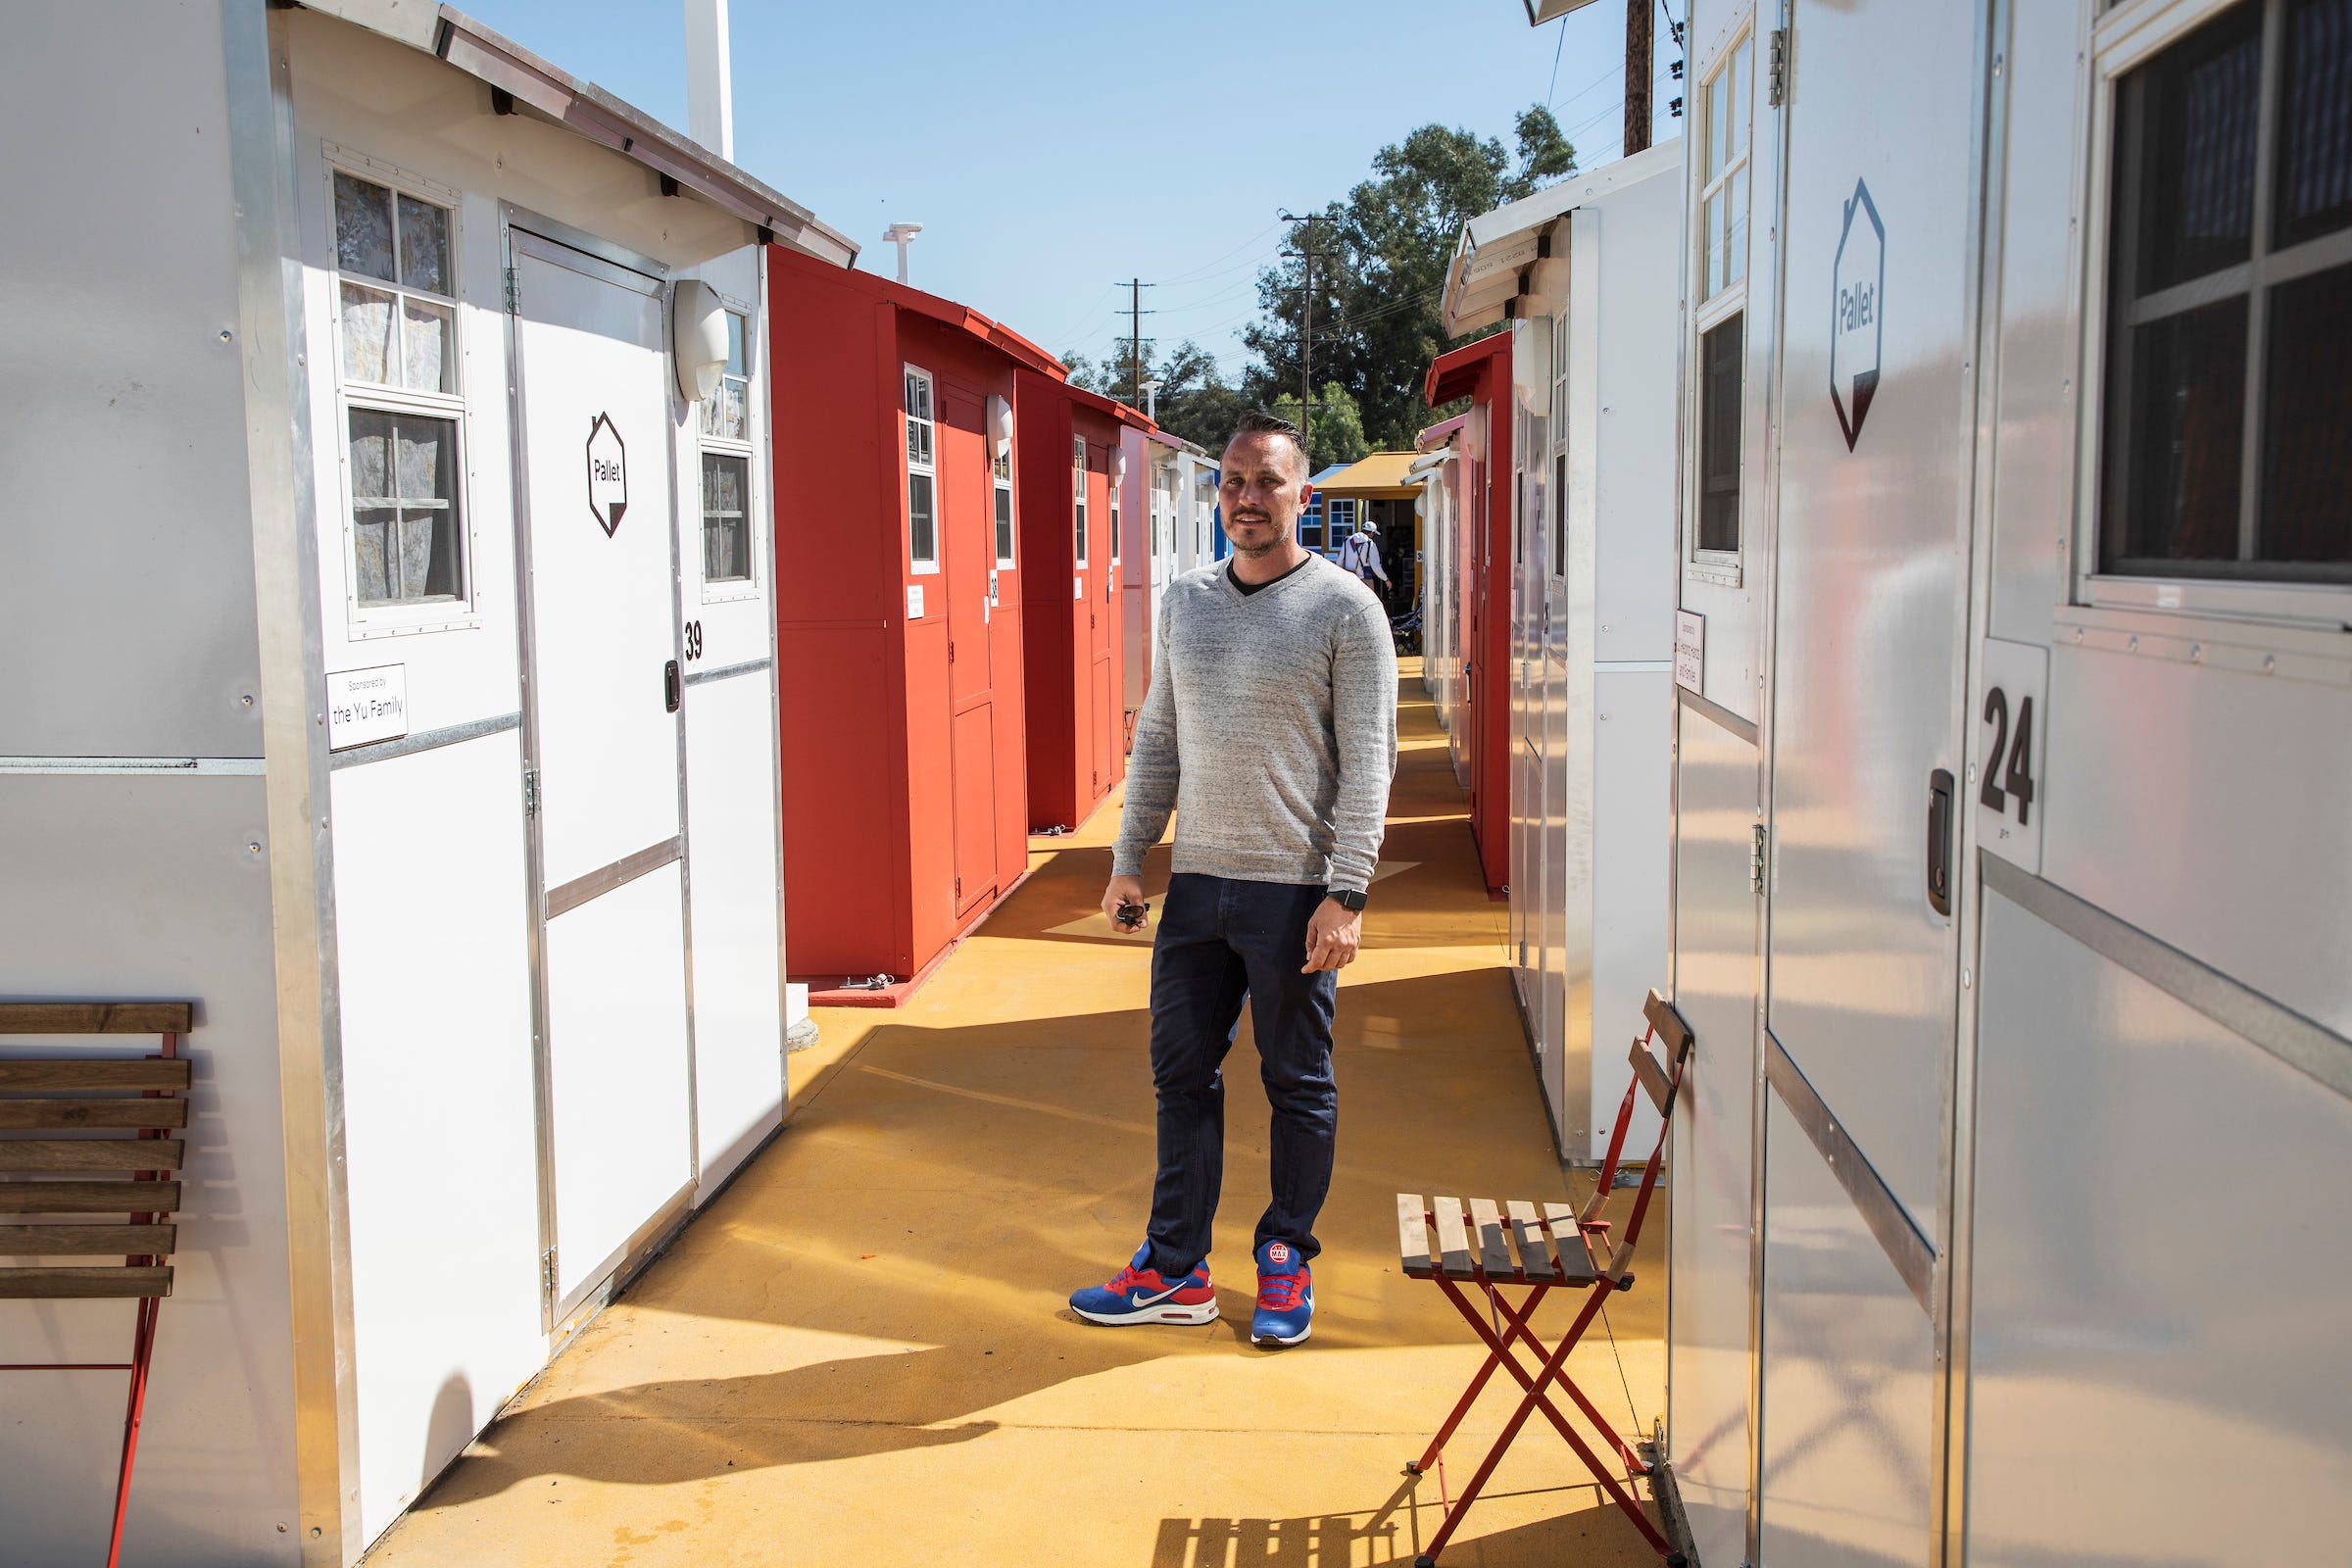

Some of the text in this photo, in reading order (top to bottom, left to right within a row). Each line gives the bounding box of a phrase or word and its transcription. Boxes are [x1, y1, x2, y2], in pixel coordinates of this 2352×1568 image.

[1839, 281, 1874, 335] Pallet
[594, 459, 620, 482] Pallet
[685, 619, 703, 662] 39
[348, 677, 386, 692] Sponsored by
[333, 695, 403, 725] the Yu Family
[1980, 686, 2034, 827] 24
